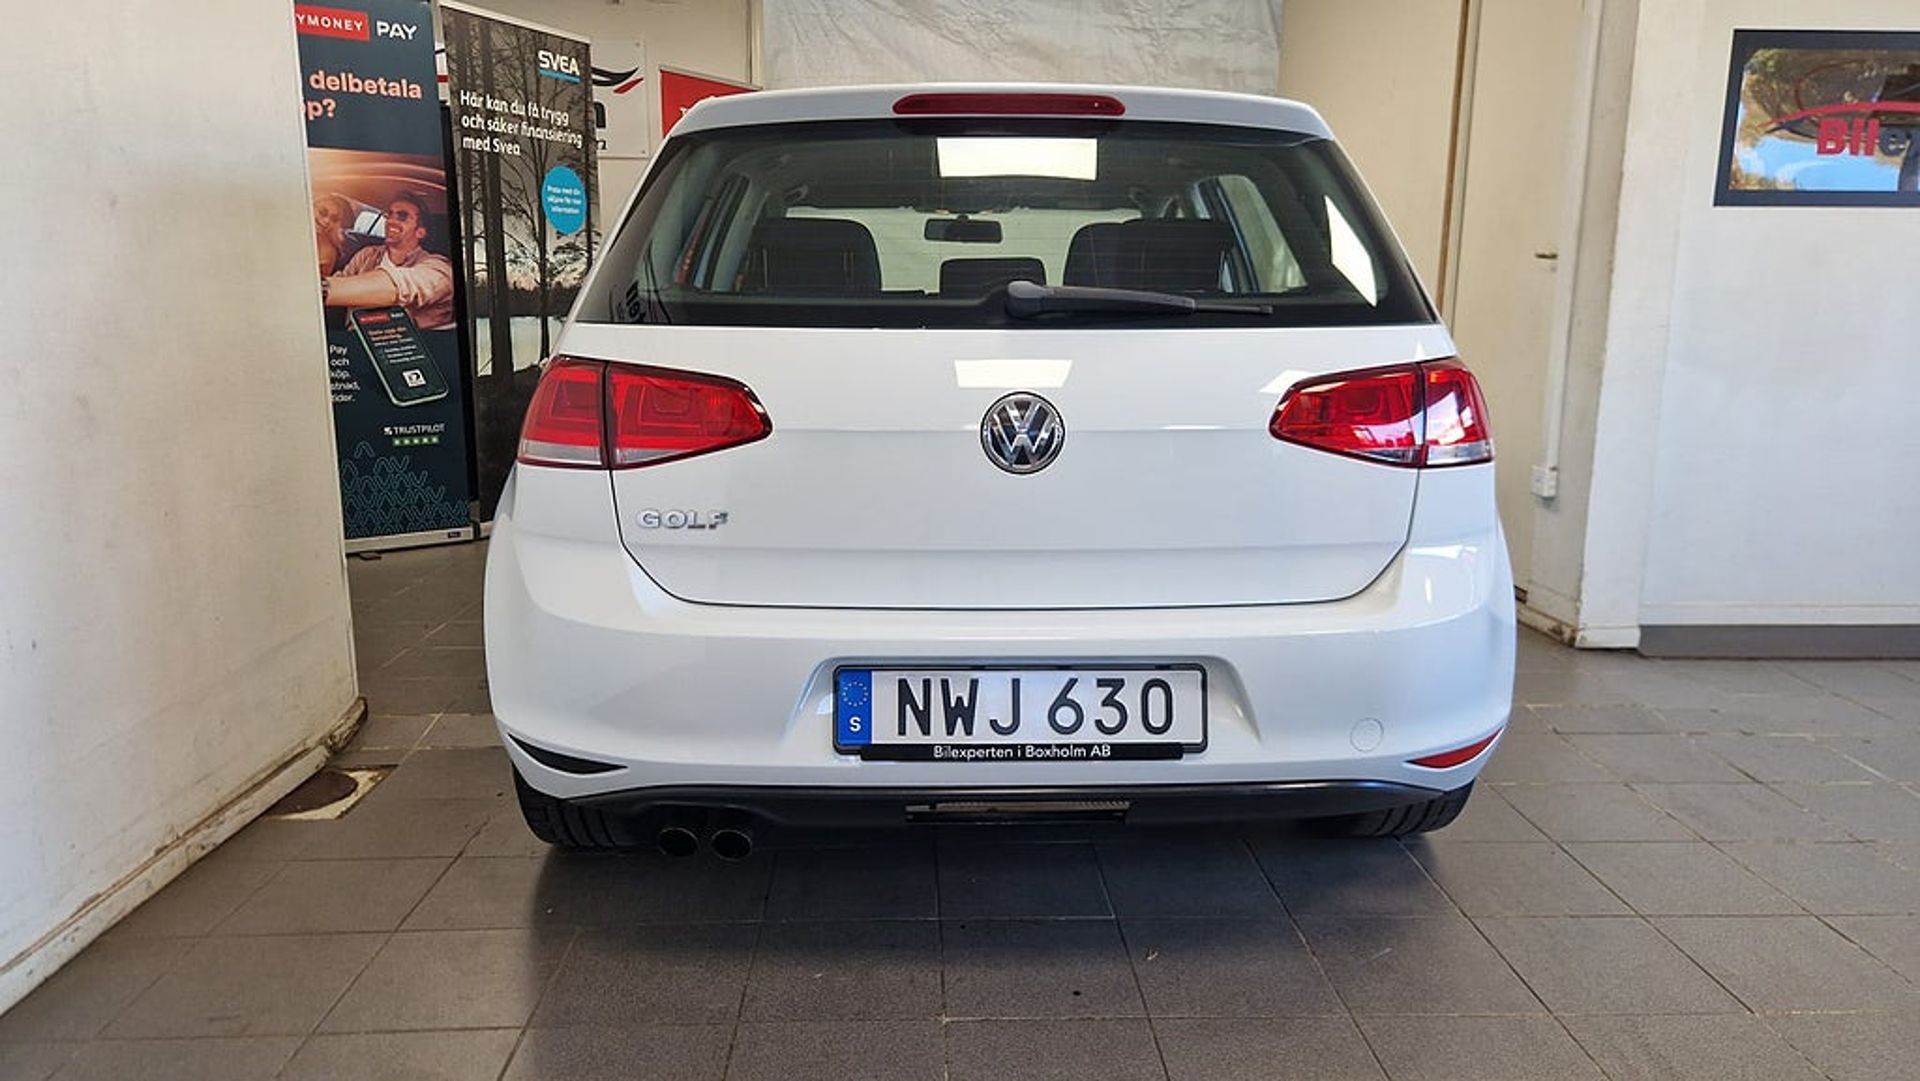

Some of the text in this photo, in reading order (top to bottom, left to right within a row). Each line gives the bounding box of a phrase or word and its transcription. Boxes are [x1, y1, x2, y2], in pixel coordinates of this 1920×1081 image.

[376, 20, 418, 40] PAY
[538, 50, 580, 75] SVEA
[309, 70, 422, 99] delbetala
[460, 89, 569, 127] Här kan du få trygg
[461, 114, 484, 129] och
[487, 117, 518, 134] säker
[521, 121, 582, 149] finansiering
[462, 136, 520, 155] med Svea
[329, 344, 347, 356] Pay
[330, 357, 349, 367] och
[393, 423, 445, 435] TRUSTPILOT
[638, 508, 729, 530] GOLF
[897, 678, 1174, 736] NWJ 630
[849, 716, 861, 732] S
[933, 744, 1111, 762] Bilexperten i Boxholm AB
